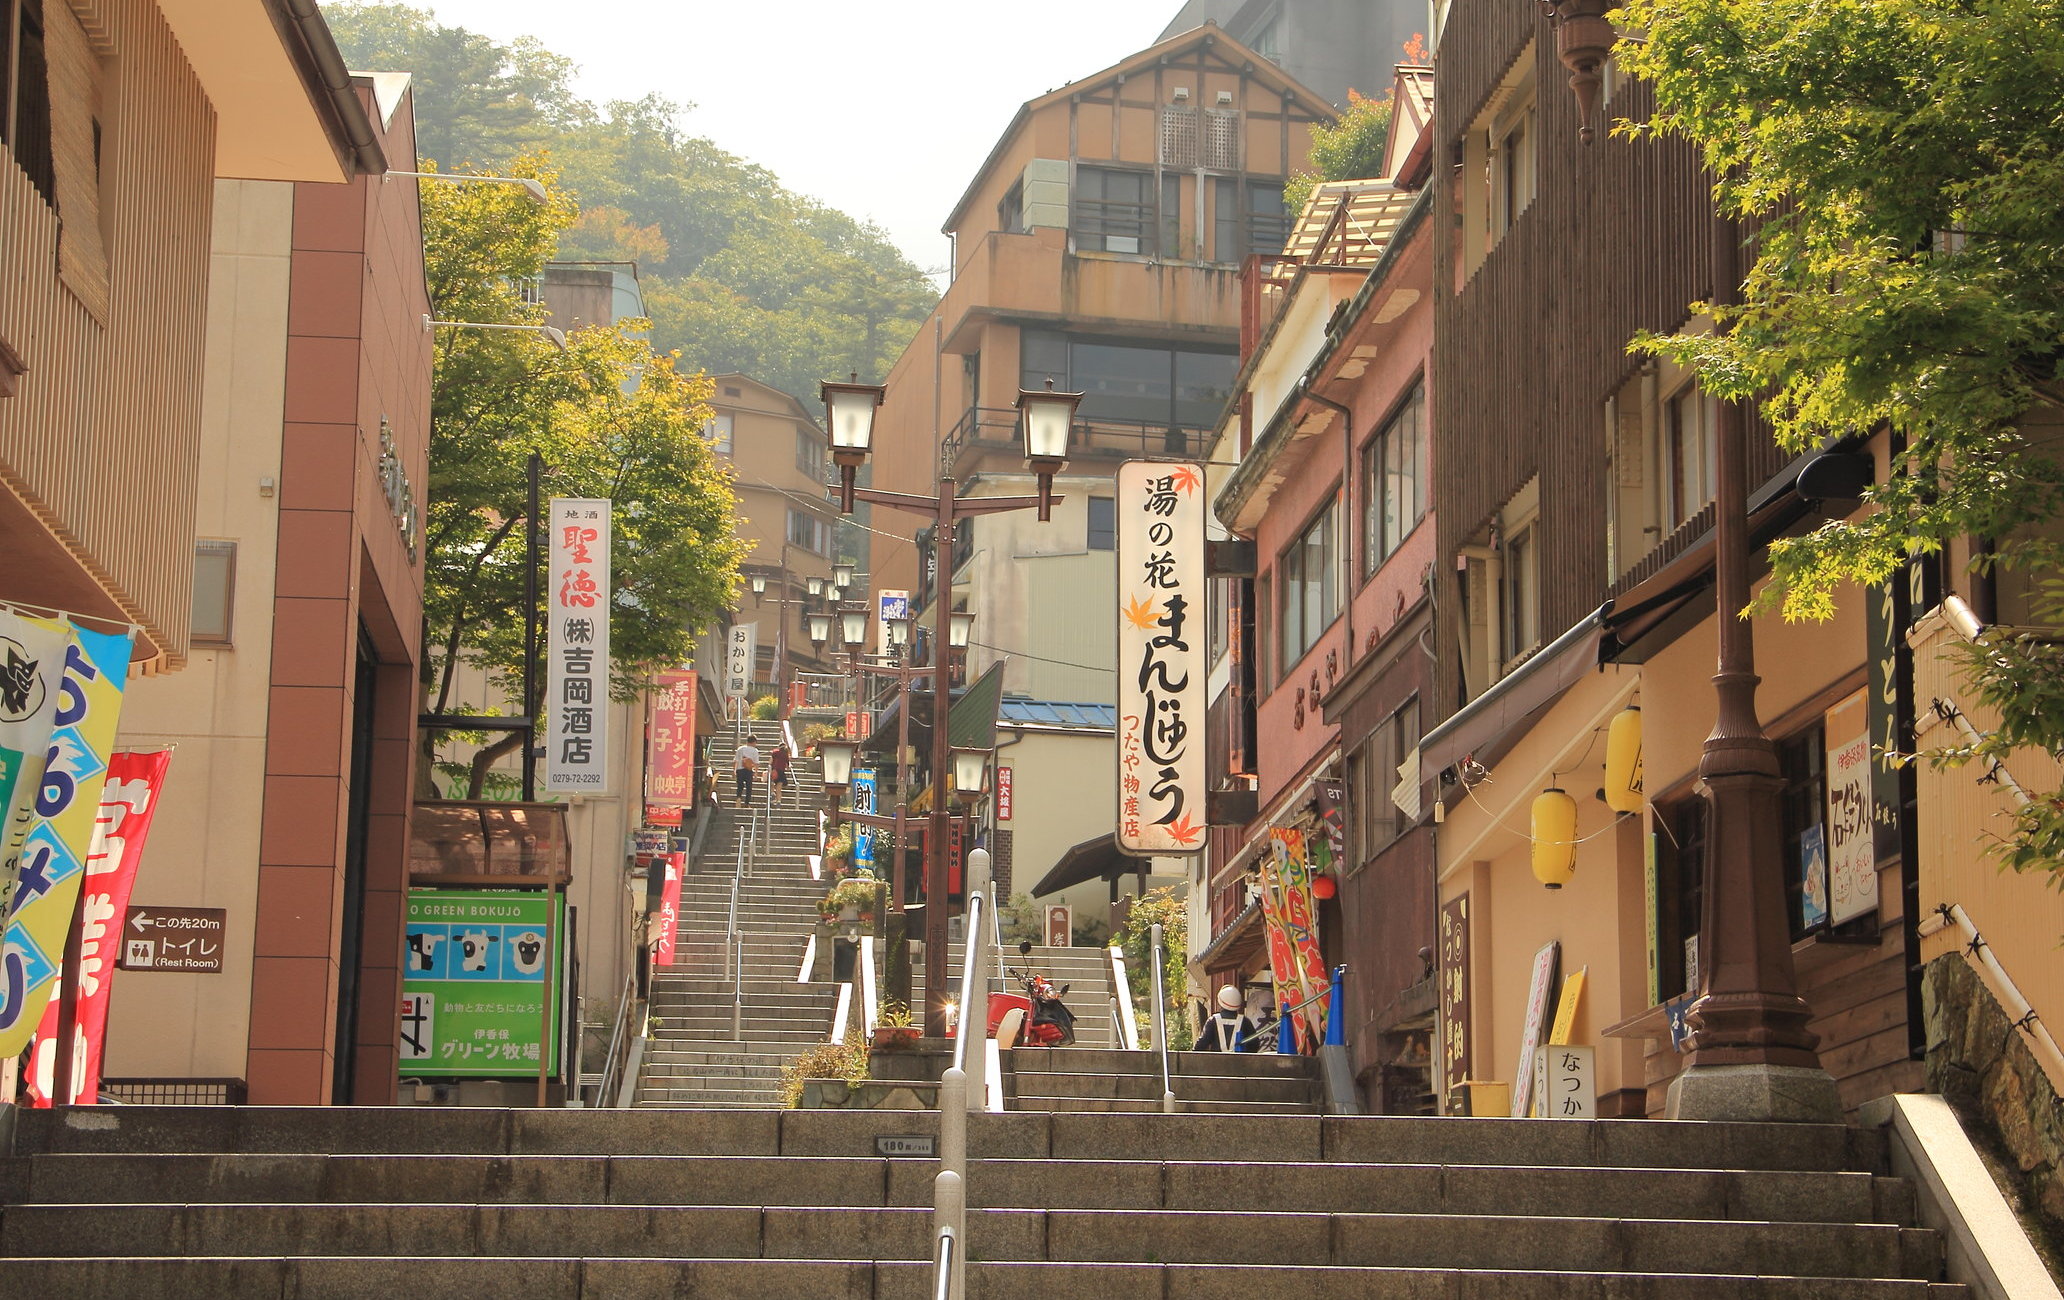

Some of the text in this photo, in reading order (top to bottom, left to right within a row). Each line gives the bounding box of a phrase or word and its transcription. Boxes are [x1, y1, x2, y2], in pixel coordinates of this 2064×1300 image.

[565, 510, 598, 519] 地酒
[559, 526, 602, 608] 聖徳
[731, 631, 746, 691] おかし屋
[672, 680, 688, 769] 手打ラーメン
[552, 774, 600, 784] 0279-72-2292
[1122, 715, 1140, 838] つたや物産店
[424, 905, 465, 916] GREEN
[156, 917, 220, 929] この先20m
[162, 937, 217, 955] トイレ
[474, 1028, 510, 1040] 伊香保
[441, 1039, 540, 1060] グリーン牧場
[1562, 1052, 1582, 1115] なつか
